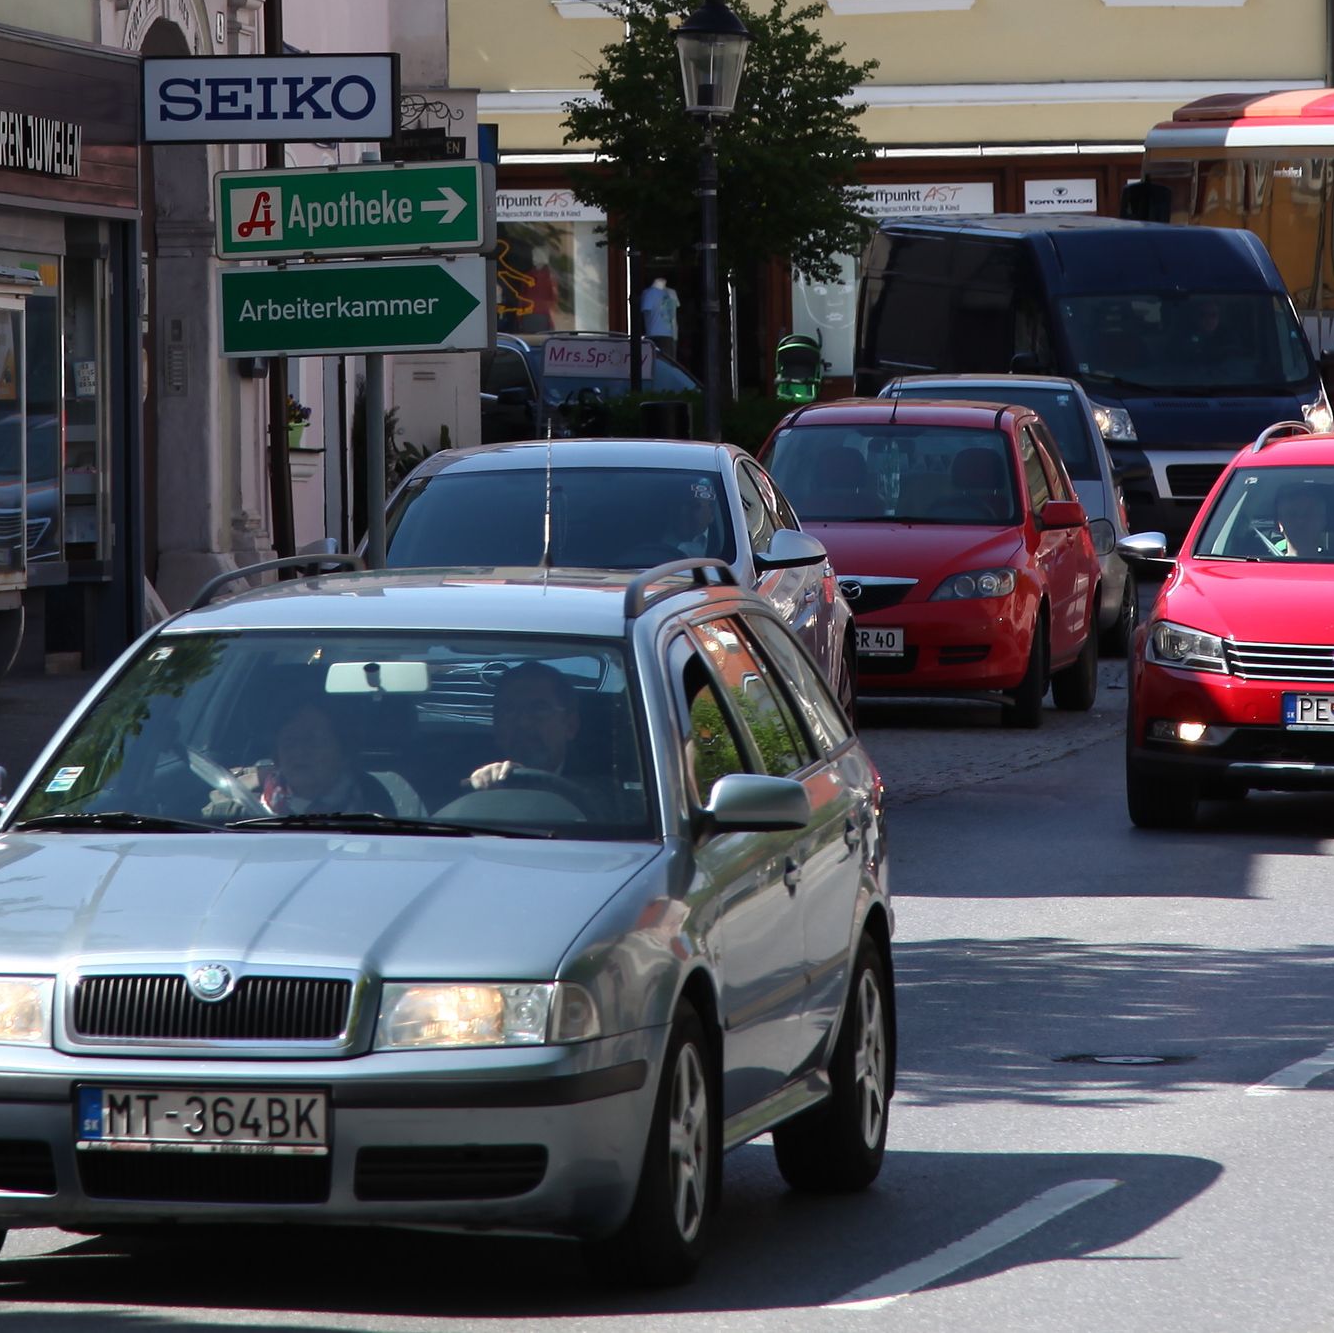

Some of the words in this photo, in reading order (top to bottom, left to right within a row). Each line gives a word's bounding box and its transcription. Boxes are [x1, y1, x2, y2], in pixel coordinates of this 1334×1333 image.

[158, 74, 377, 122] SEIKO
[26, 115, 82, 178] JUWELEN
[923, 185, 963, 202] AST
[287, 189, 413, 237] Apotheke
[238, 295, 439, 322] Arbeiterkammer
[855, 631, 870, 648] CR
[875, 631, 895, 648] 40
[1299, 697, 1329, 722] PE
[83, 1119, 99, 1131] SK
[107, 1093, 318, 1139] MT-364BK
